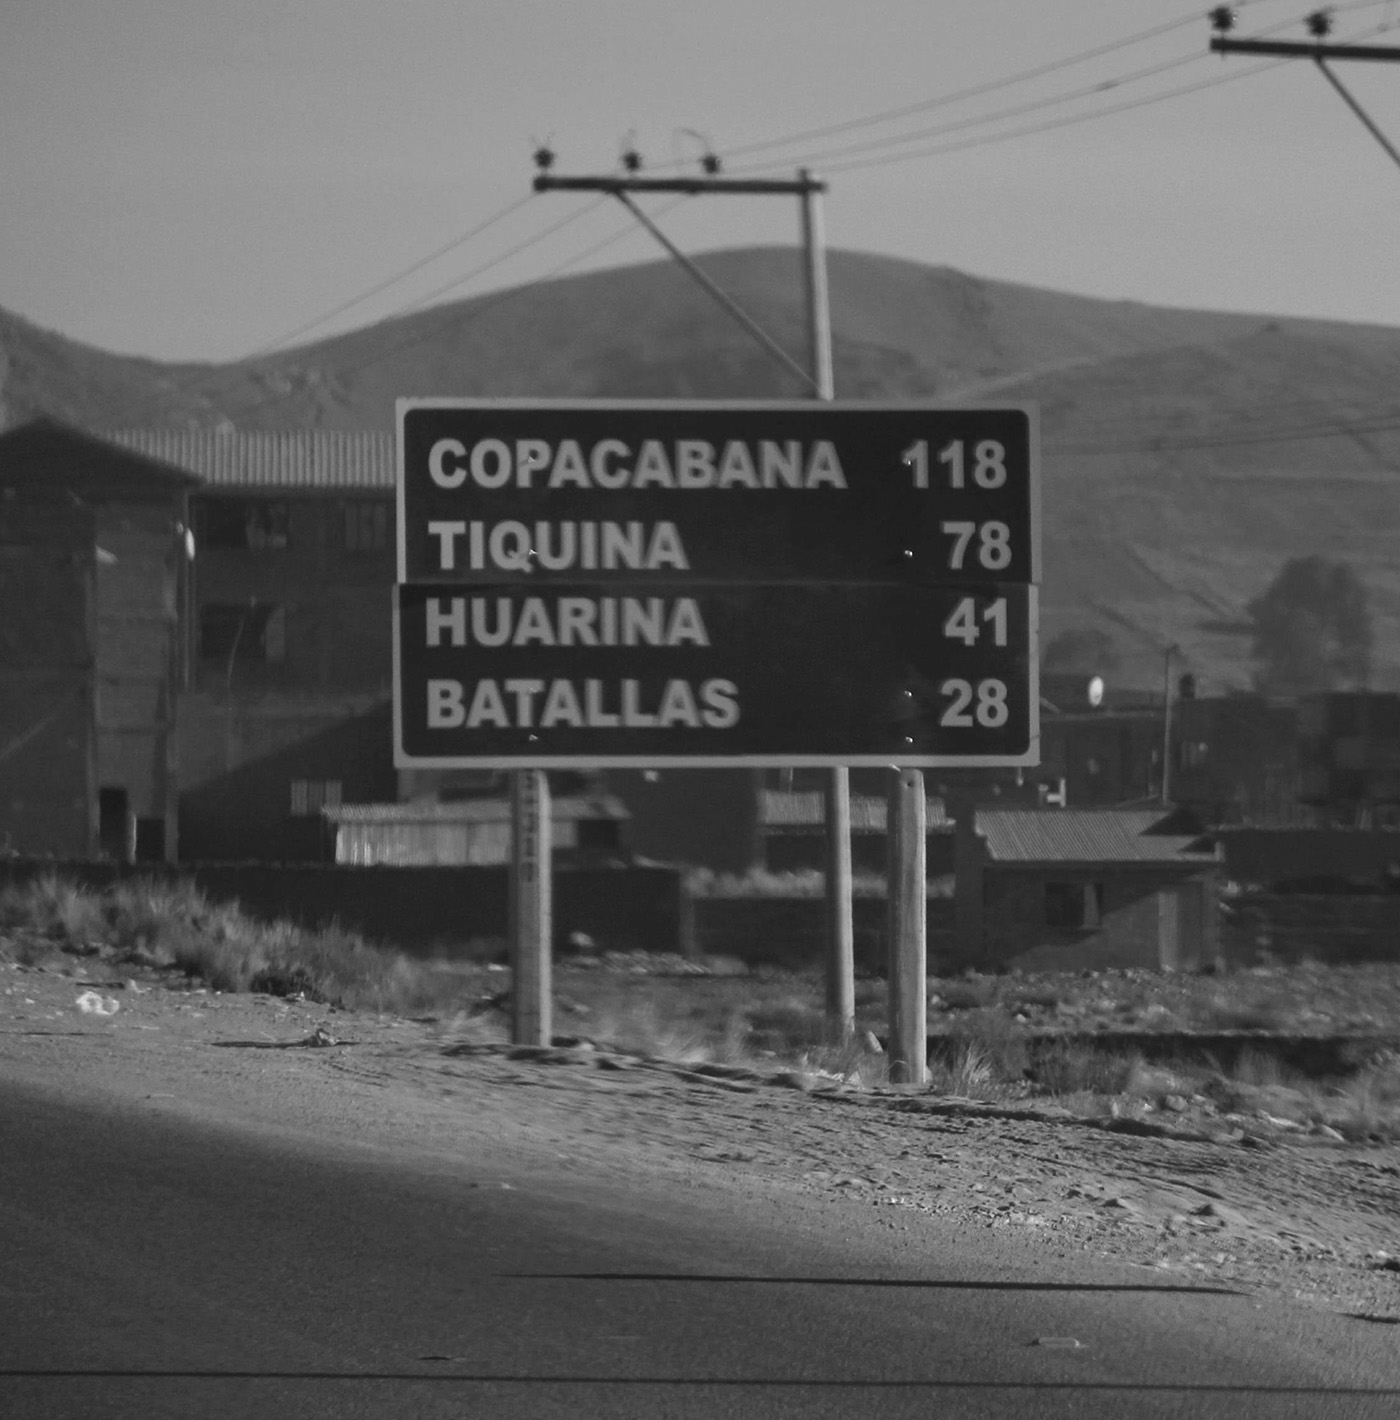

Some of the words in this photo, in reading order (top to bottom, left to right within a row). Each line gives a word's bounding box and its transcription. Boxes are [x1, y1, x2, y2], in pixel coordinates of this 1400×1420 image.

[428, 437, 848, 489] COPACABANA
[902, 439, 1007, 489] 118
[427, 519, 690, 574] TIQUINA
[942, 520, 1012, 570] 78
[425, 597, 710, 647] HUARINA
[944, 597, 1008, 647] 41
[427, 678, 740, 729] BATALLAS
[940, 678, 1009, 728] 28
